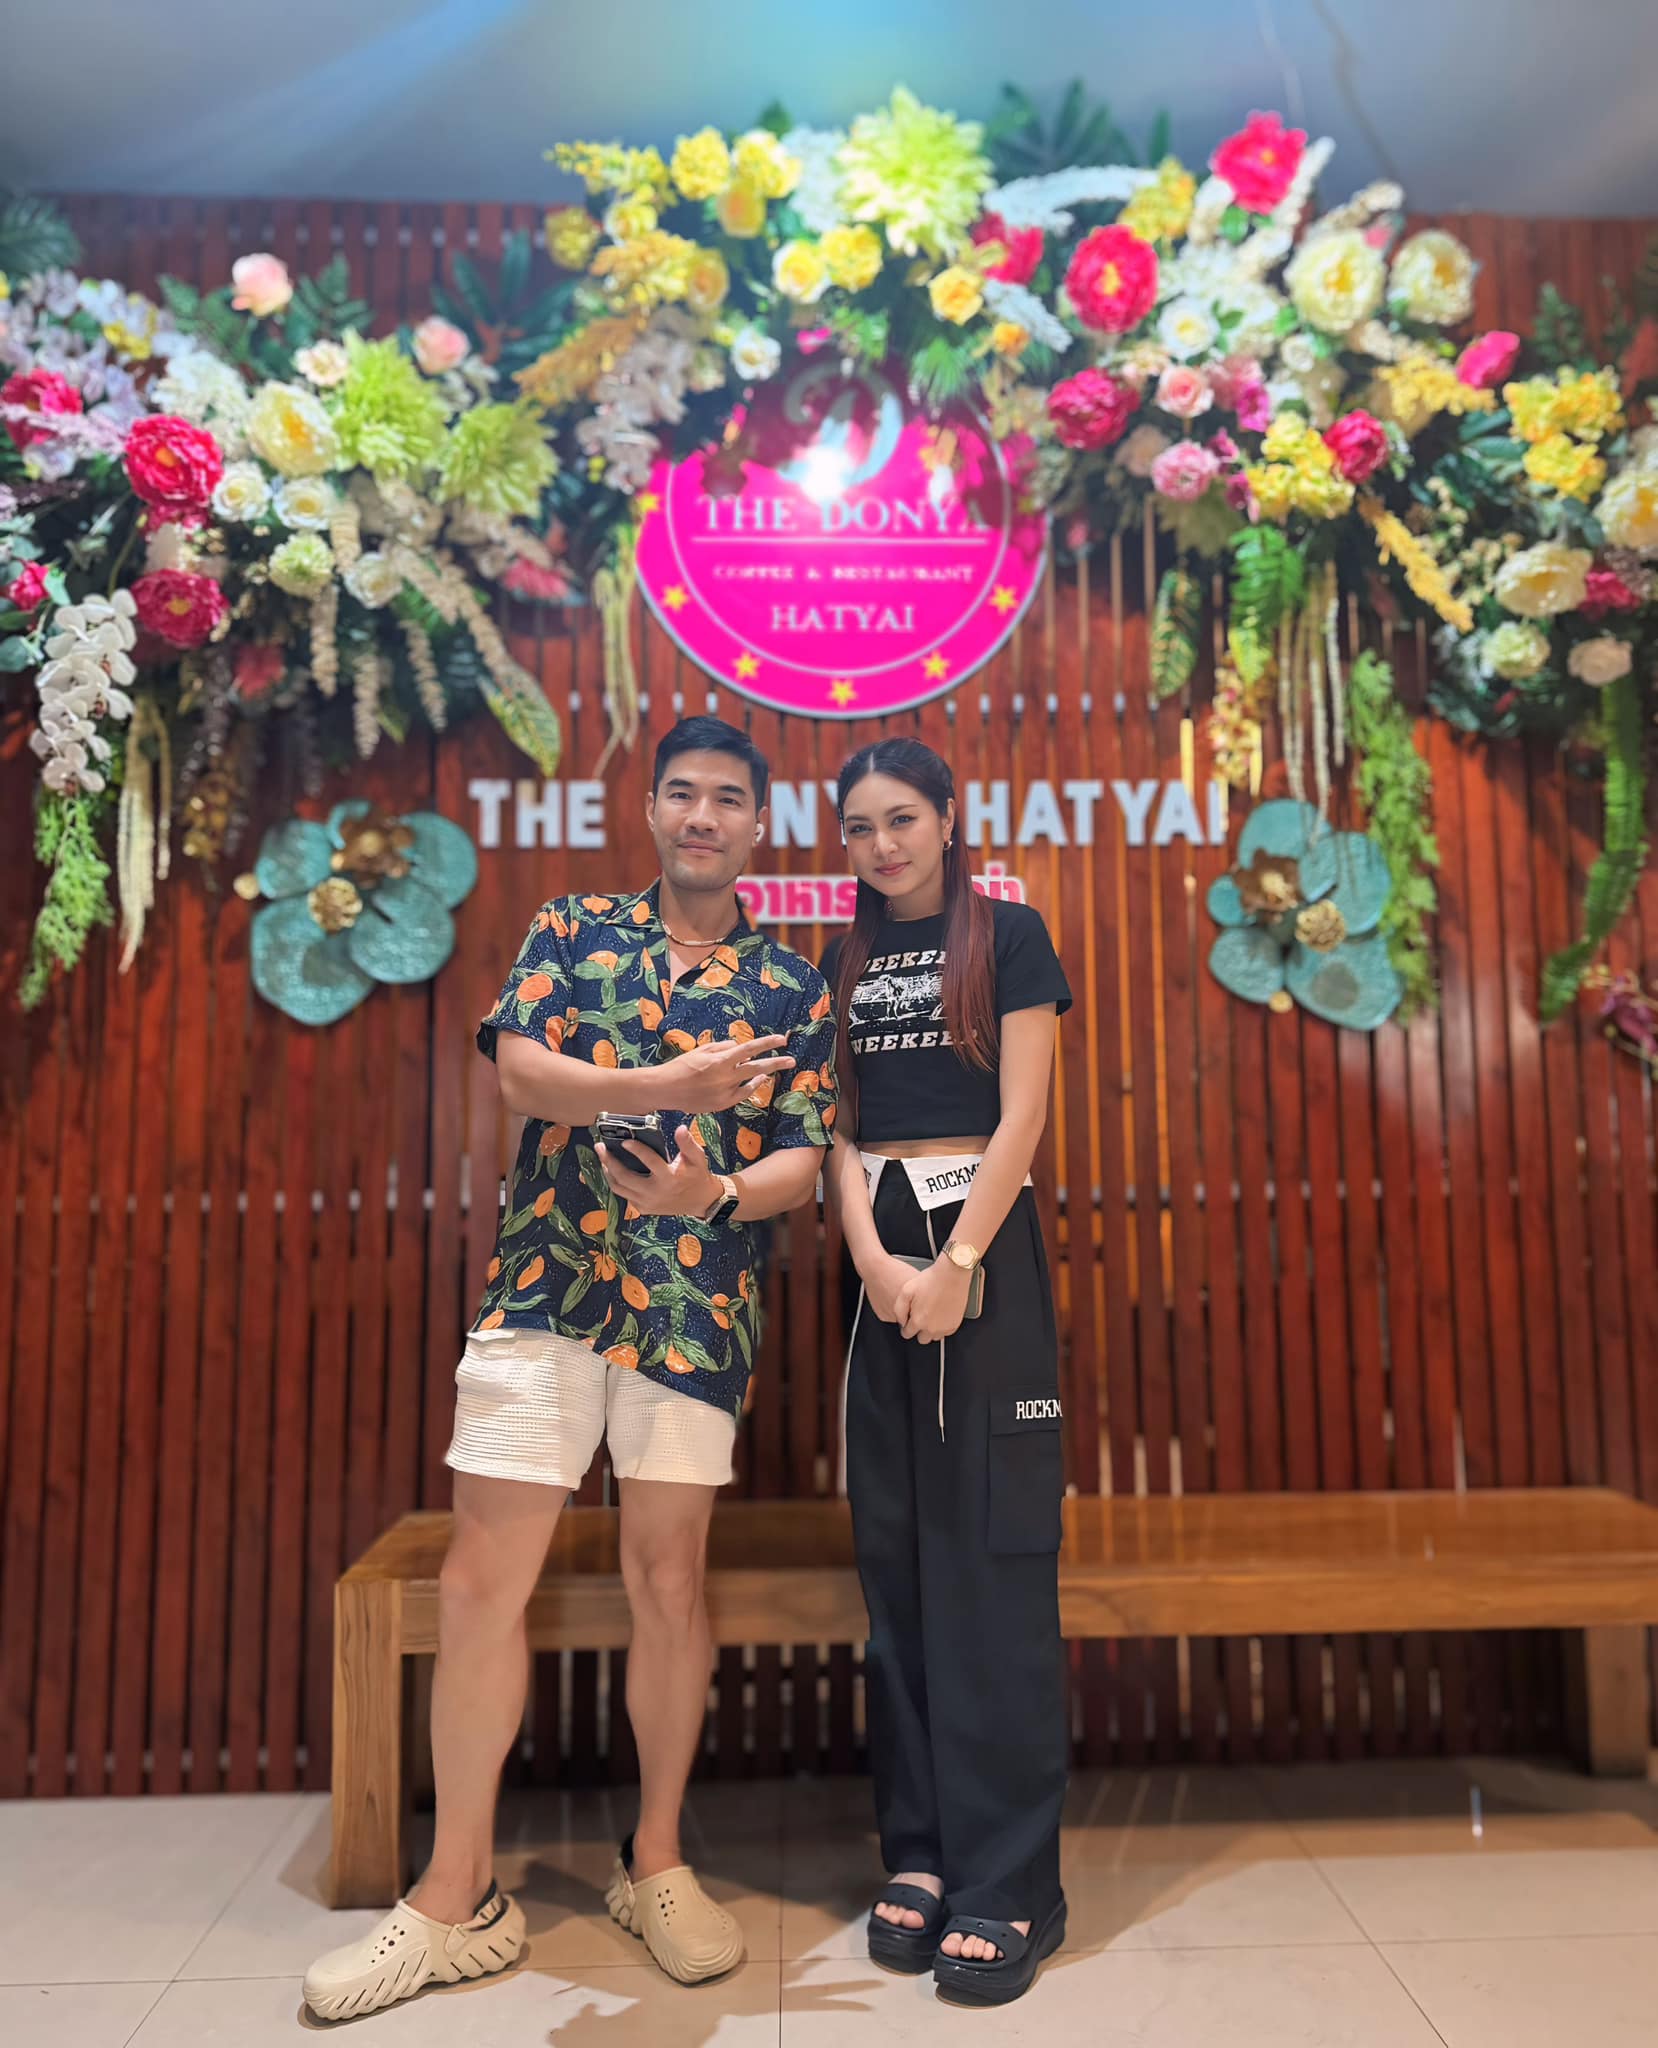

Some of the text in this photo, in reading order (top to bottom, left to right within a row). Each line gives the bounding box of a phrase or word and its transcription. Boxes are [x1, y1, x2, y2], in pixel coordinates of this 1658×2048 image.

[702, 497, 797, 530] THE
[832, 565, 974, 581] RESTAURANT
[771, 604, 917, 631] HATYAI
[469, 780, 1227, 848] THE HATYAI
[925, 1163, 979, 1193] ROCKM
